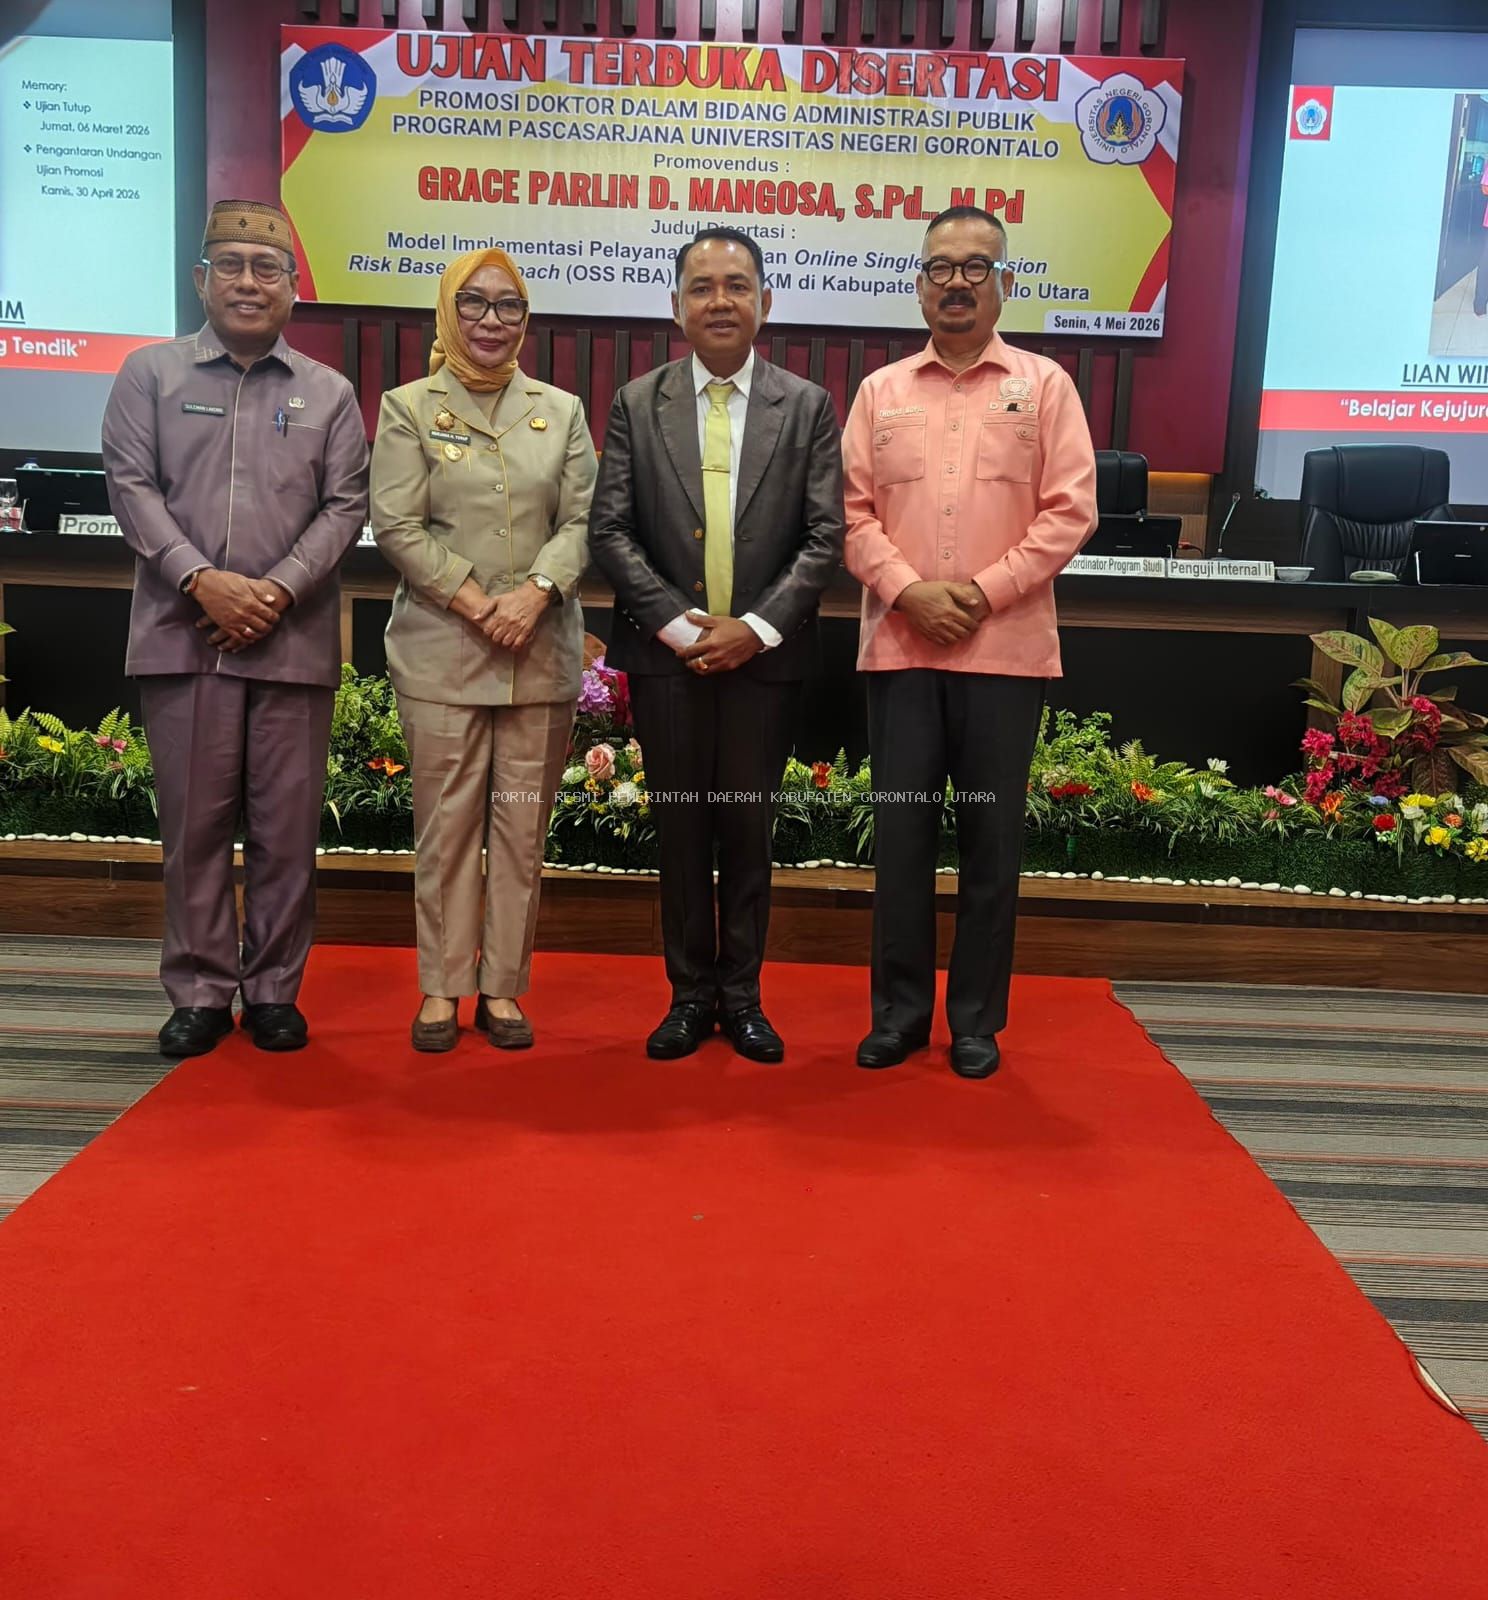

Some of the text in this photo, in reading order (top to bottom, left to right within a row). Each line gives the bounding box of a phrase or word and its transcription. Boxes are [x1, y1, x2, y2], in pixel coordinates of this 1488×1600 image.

[397, 33, 1061, 101] UJIAN TERBUKA DISERTASI
[21, 80, 67, 93] Memory:
[35, 101, 91, 115] Ujian Tutup
[420, 90, 1034, 131] PROMOSI DOKTOR DALAM BIDANG ADMINISTRASI PUBLIK
[40, 121, 150, 135] Jumat, 06 Maret 2026
[1088, 88, 1152, 154] UNIVERSITAS NEGERI GORONTALO
[393, 115, 1059, 158] PROGRAM PASCASARJANA UNIVERSITAS NEGERI GORONTALO
[36, 144, 162, 161] Pengantaran Undangan
[36, 165, 104, 178] Ujian Promosi
[654, 154, 778, 172] Promovendus
[41, 185, 140, 200] Kamis, 30 April 2026
[418, 166, 519, 204] GRACE
[529, 170, 639, 208] PARLIN
[648, 176, 679, 211] D.
[688, 177, 845, 222] MANGOSA,
[950, 187, 1024, 224] MPd
[651, 219, 700, 235] Judul
[388, 232, 445, 250] Model
[590, 241, 678, 262] Pelayana
[349, 255, 446, 275] Risk Base
[795, 249, 857, 267] Online
[566, 264, 615, 285] (OSS
[622, 267, 672, 288] RBA)
[798, 274, 815, 290] di
[823, 275, 915, 296] Kabupate
[1038, 282, 1089, 300] Utara
[1054, 315, 1160, 331] Senin, 4 Mei 2026
[1402, 363, 1451, 384] LIAN
[64, 516, 119, 534] Prom
[1108, 558, 1141, 574] Program
[1142, 559, 1163, 572] Studi
[1170, 561, 1214, 577] Penguji
[1217, 562, 1261, 576] Internal
